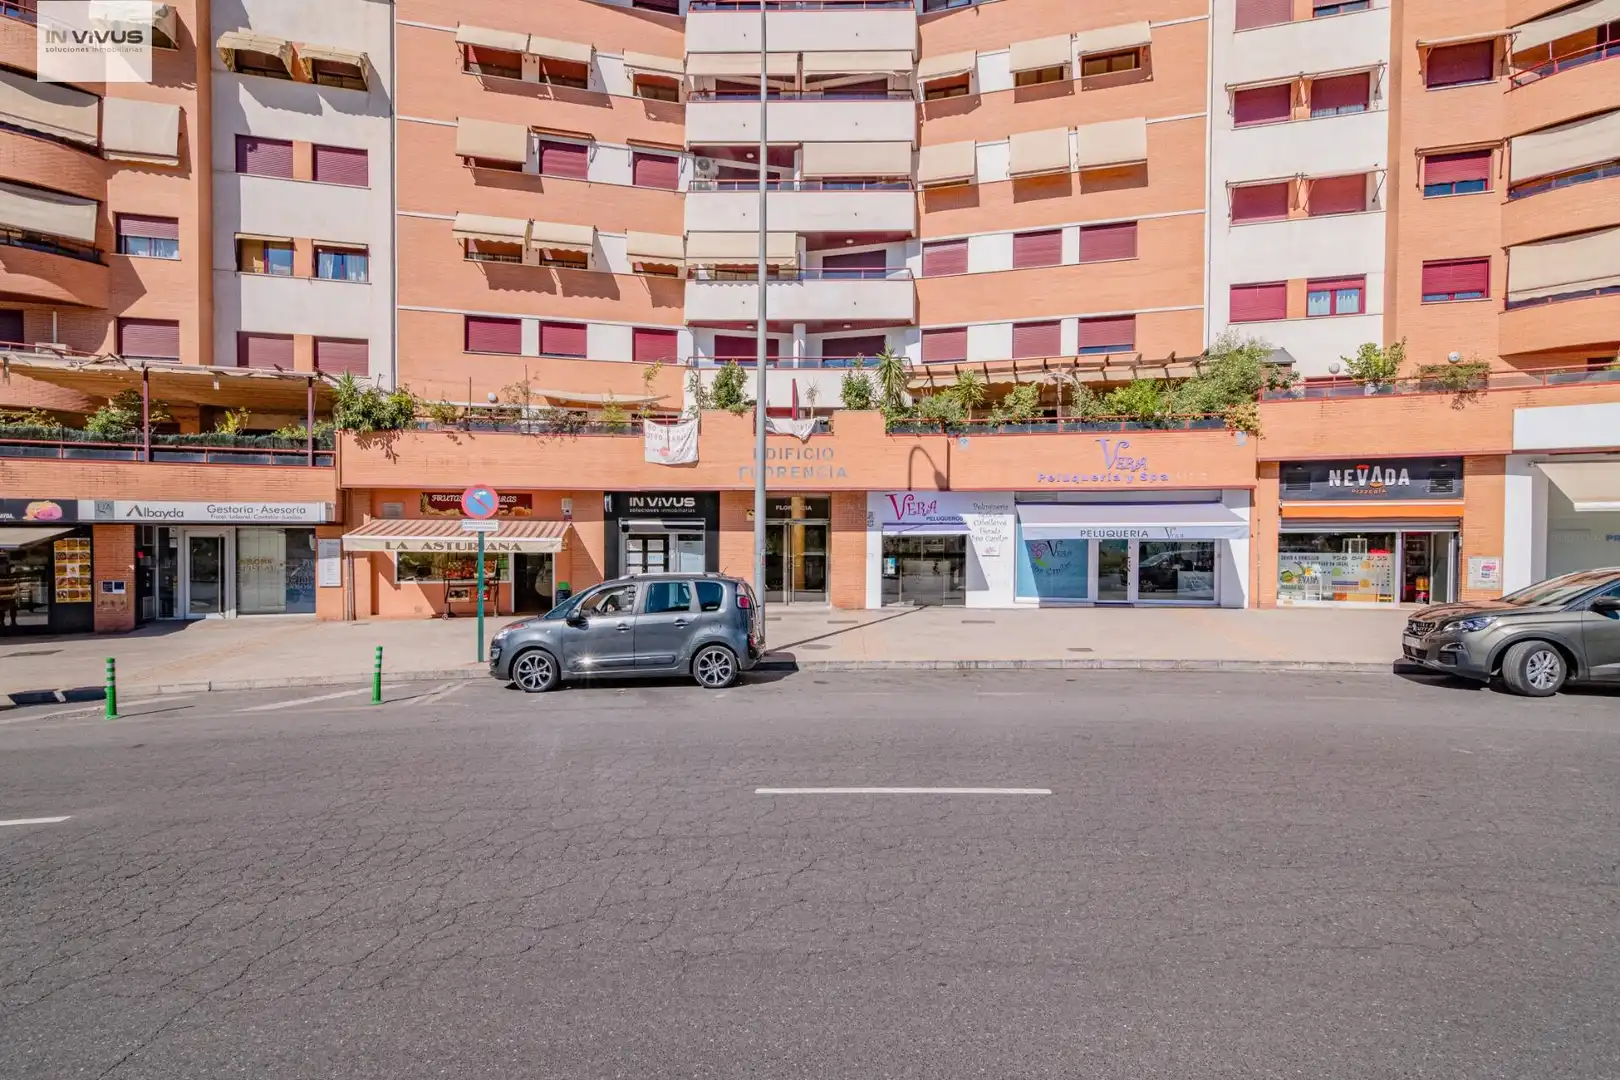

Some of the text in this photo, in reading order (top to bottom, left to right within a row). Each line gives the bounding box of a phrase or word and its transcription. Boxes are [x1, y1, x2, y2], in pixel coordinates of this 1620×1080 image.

[754, 447, 835, 461] DIFICIO
[1139, 472, 1169, 483] Spa
[1329, 465, 1411, 487] NEVADA
[629, 496, 645, 507] IN
[885, 493, 938, 520] VERA
[126, 504, 184, 519] Albayda
[1080, 529, 1149, 538] PELUQUERIA
[385, 541, 523, 551] LA ASTURANA
